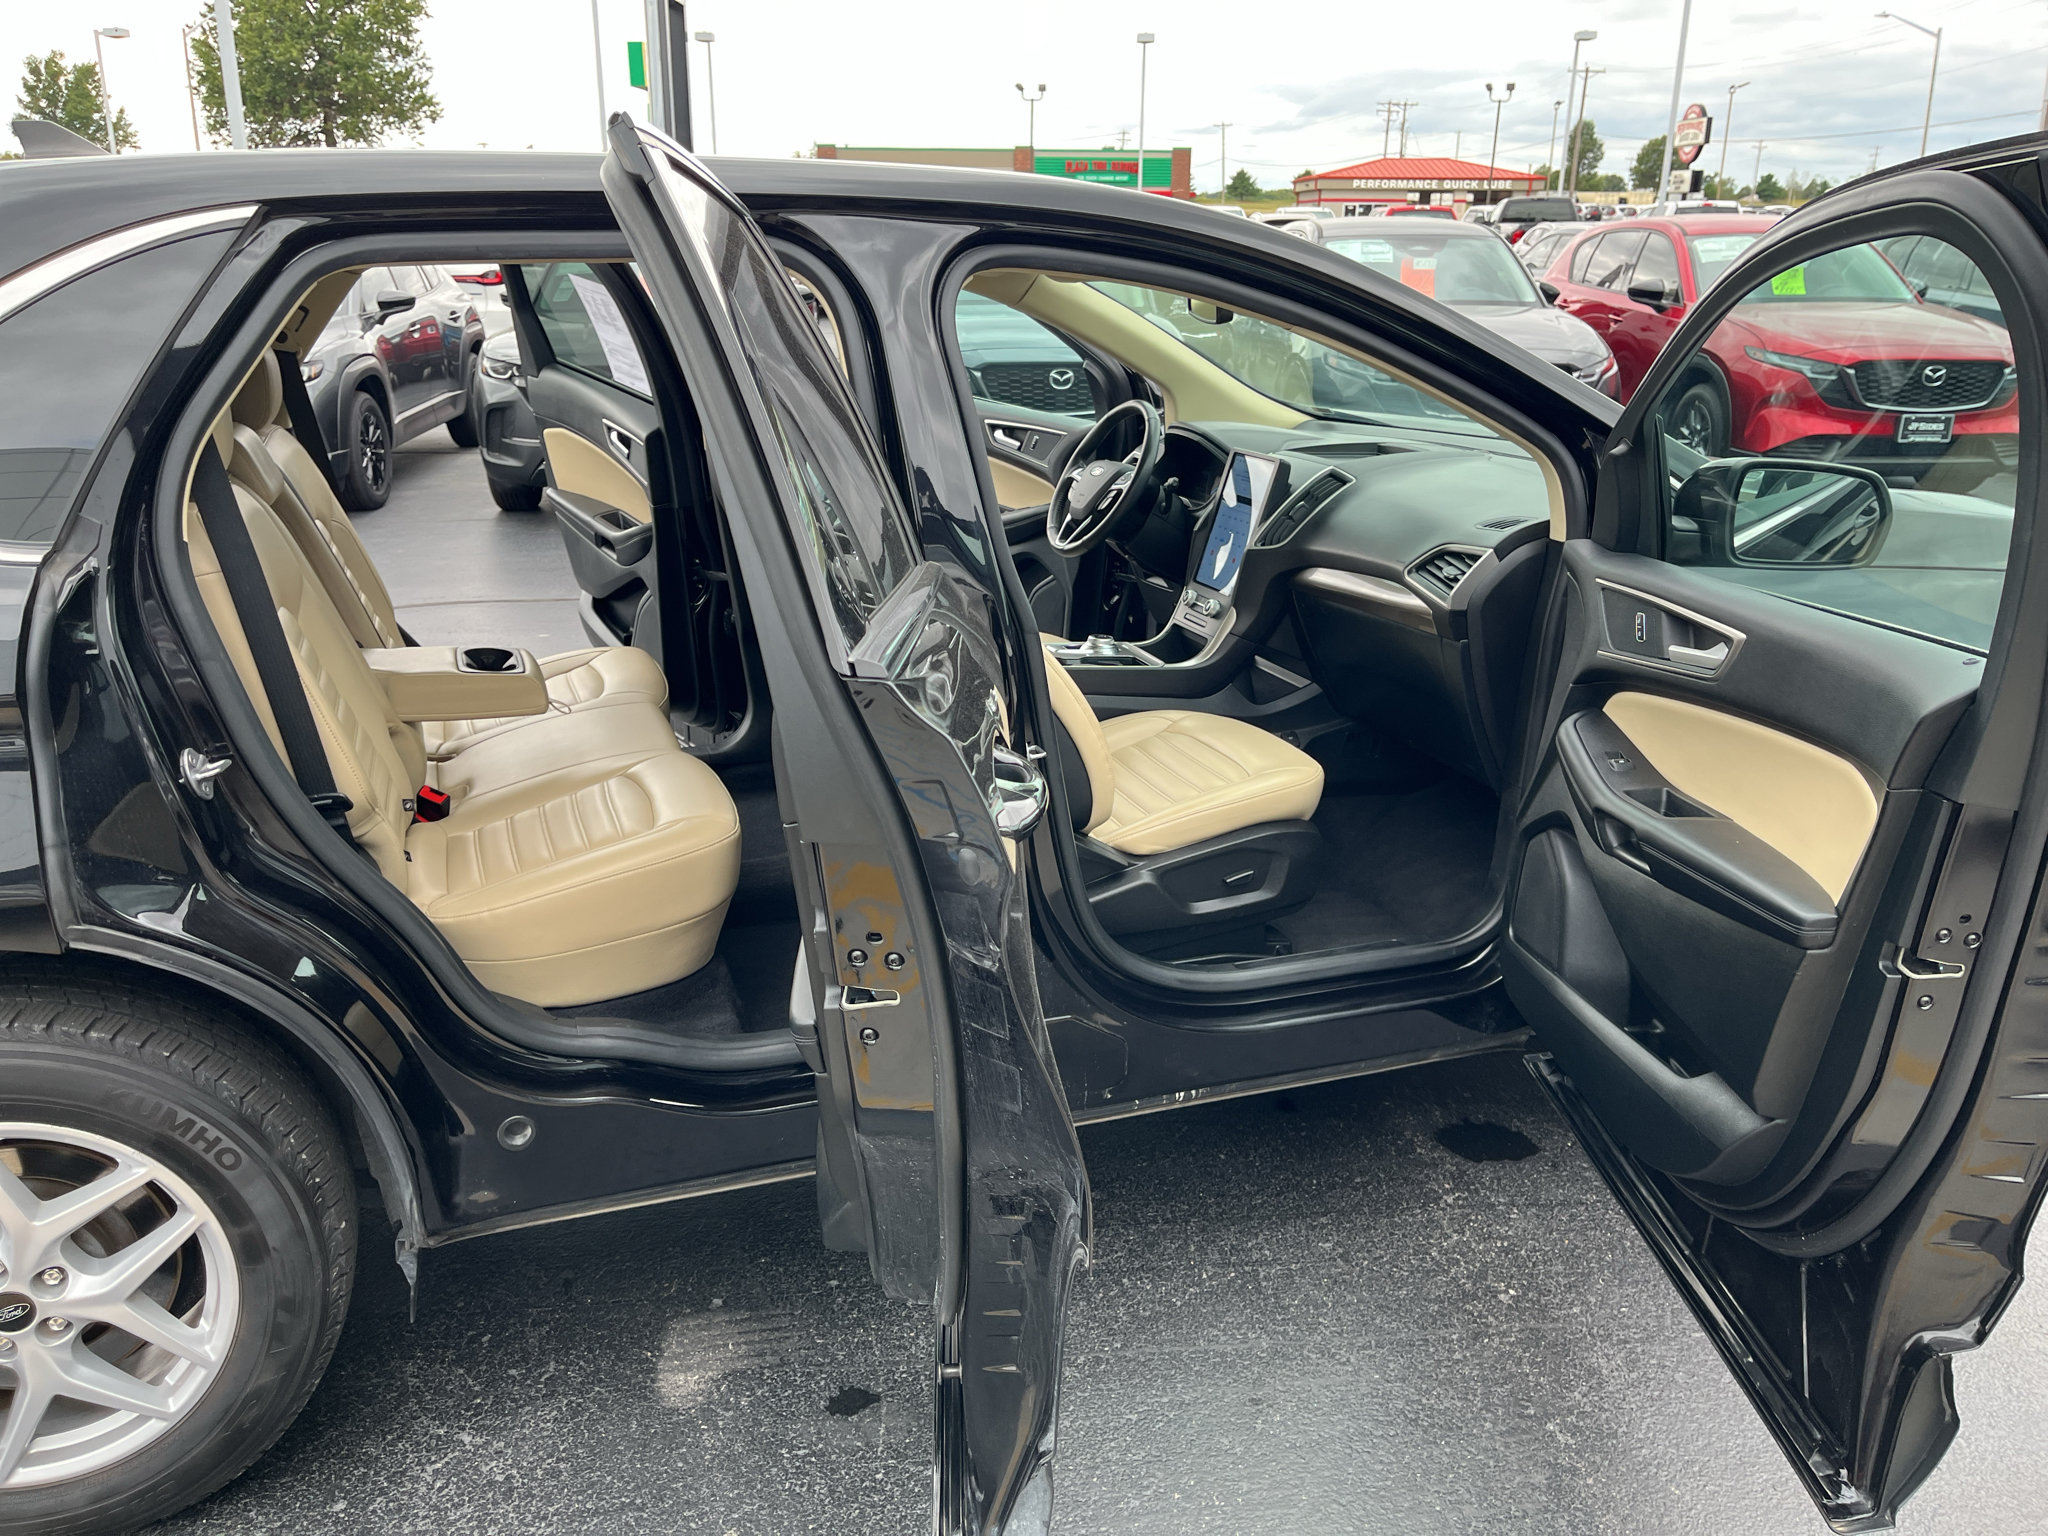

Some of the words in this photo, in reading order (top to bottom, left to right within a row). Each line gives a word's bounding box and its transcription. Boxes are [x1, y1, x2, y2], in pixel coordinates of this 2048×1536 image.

[1352, 179, 1438, 189] PERFORMANCE
[1443, 179, 1478, 189] QUICK
[1483, 179, 1513, 189] LUBE
[110, 1089, 242, 1171] KUMHO
